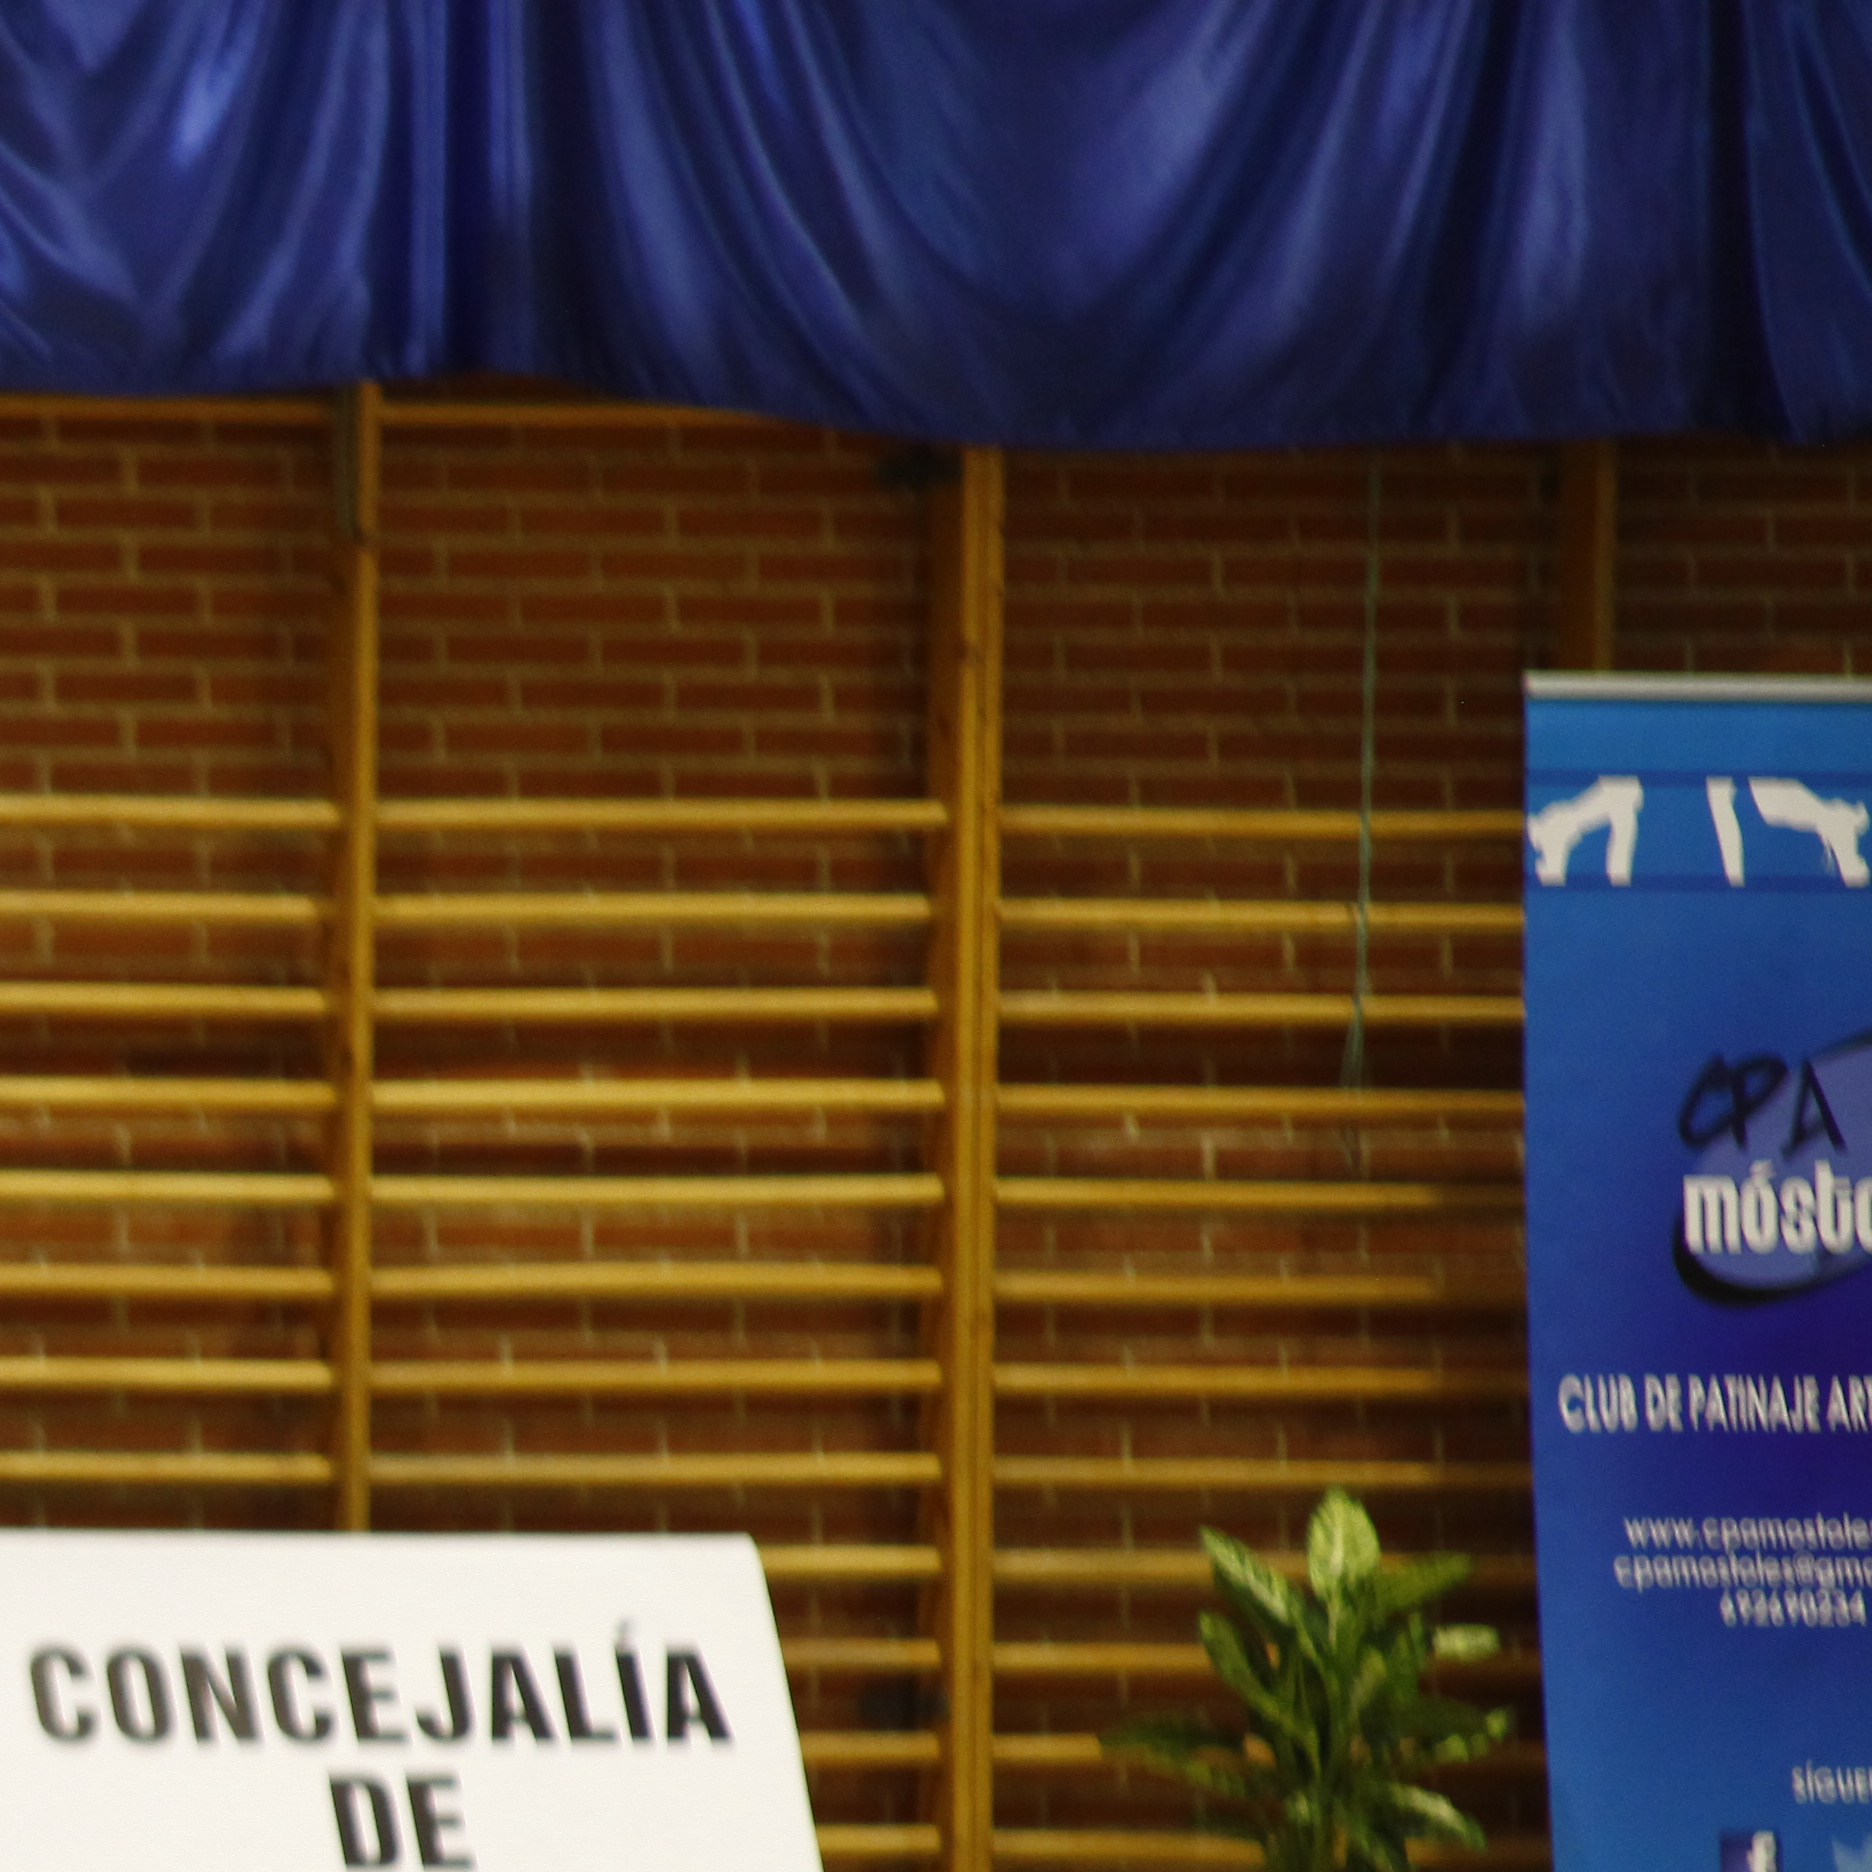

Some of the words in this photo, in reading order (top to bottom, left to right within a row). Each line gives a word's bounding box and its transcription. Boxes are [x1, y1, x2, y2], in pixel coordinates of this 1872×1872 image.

[1677, 1053, 1850, 1162] CPA
[1558, 1373, 1639, 1434] CLUB
[1643, 1373, 1684, 1434] DE
[1688, 1373, 1822, 1434] PATINAJE
[1622, 1510, 1872, 1552] www.cpamostole
[27, 1616, 736, 1746] CONCEJALÍA
